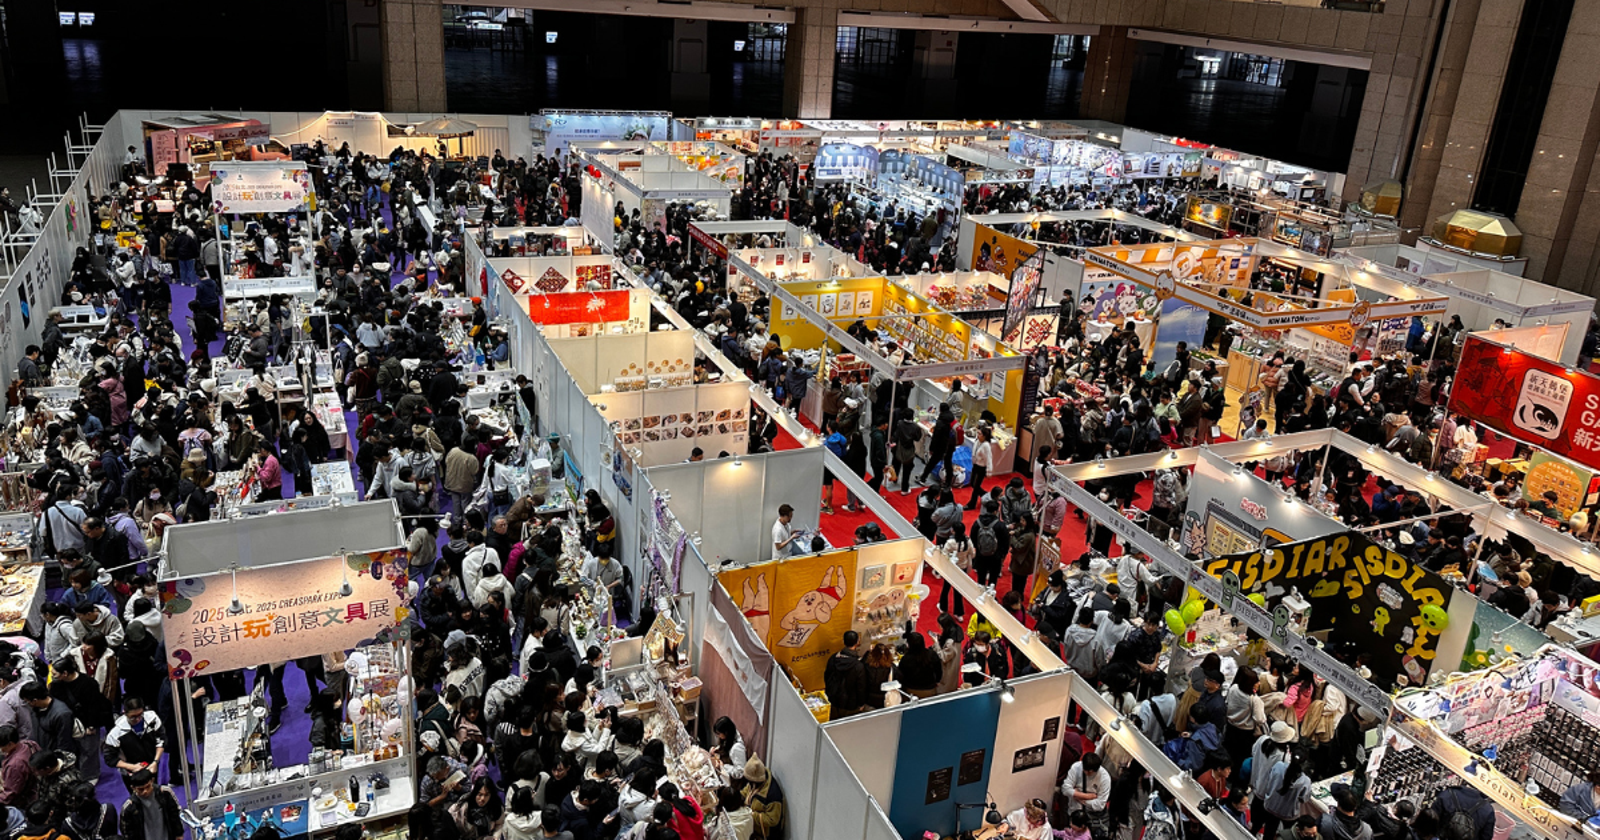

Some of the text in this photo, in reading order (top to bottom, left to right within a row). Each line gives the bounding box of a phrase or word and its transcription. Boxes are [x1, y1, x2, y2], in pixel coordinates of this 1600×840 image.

[256, 601, 277, 612] 2025
[279, 593, 324, 609] CREASPARK
[192, 598, 391, 648] 設計玩創意文具展
